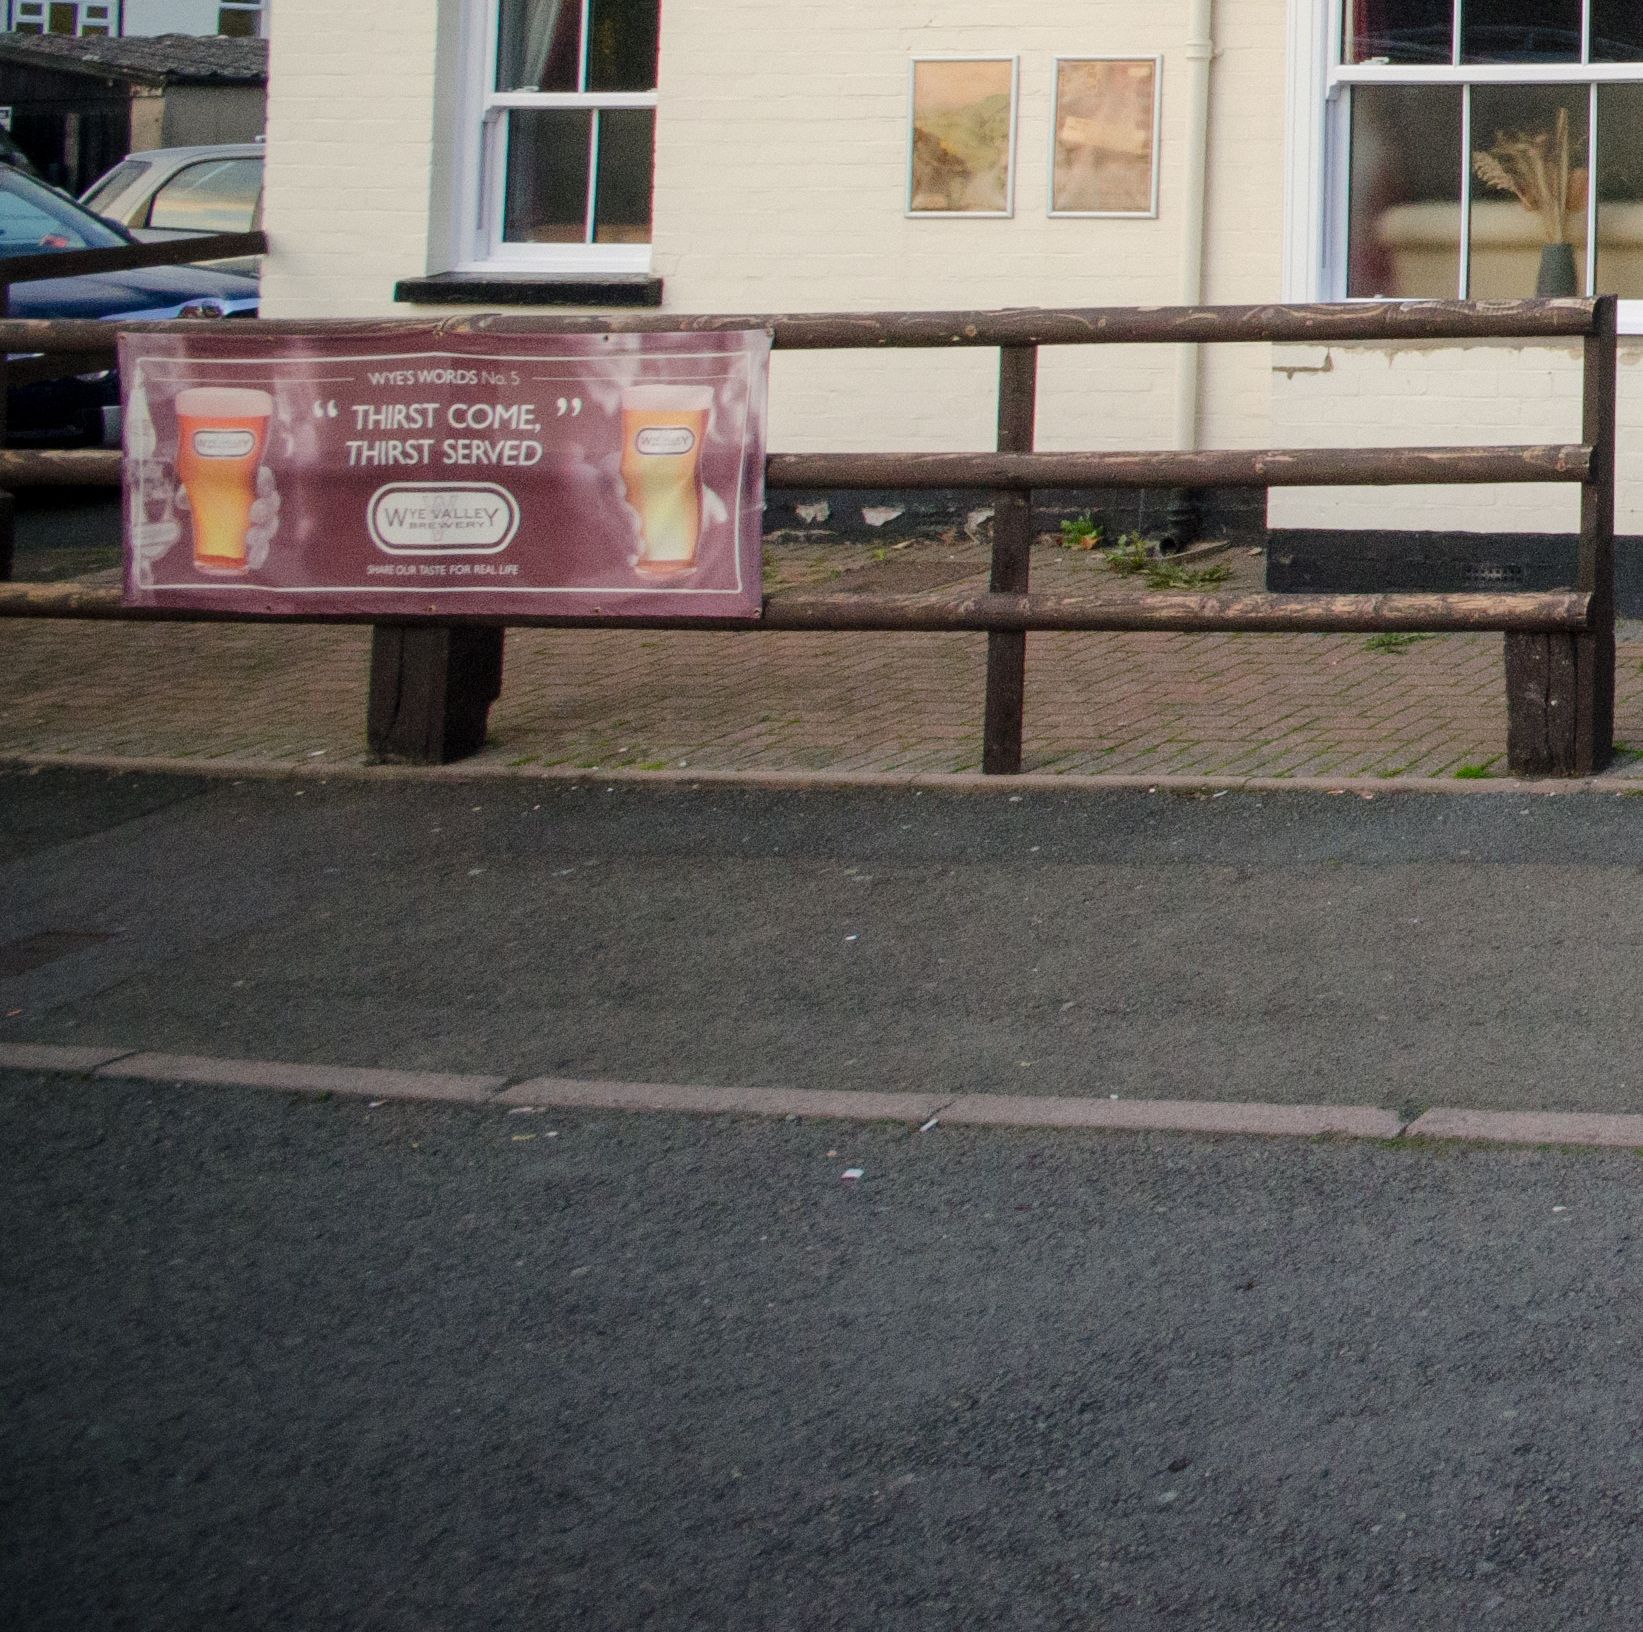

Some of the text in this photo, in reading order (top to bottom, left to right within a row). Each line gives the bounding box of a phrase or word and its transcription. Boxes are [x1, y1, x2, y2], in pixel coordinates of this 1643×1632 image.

[418, 369, 478, 385] WORDS
[510, 371, 520, 385] 5
[351, 403, 542, 433] THIRST COME,
[345, 439, 543, 466] THIRST SERVED
[384, 507, 499, 528] WYE VALLEY
[409, 521, 485, 529] BREWERY
[396, 564, 416, 576] OUR
[419, 564, 447, 576] TASTE
[450, 564, 471, 576] FOR
[474, 564, 497, 576] REAL
[498, 564, 520, 576] LIFE
